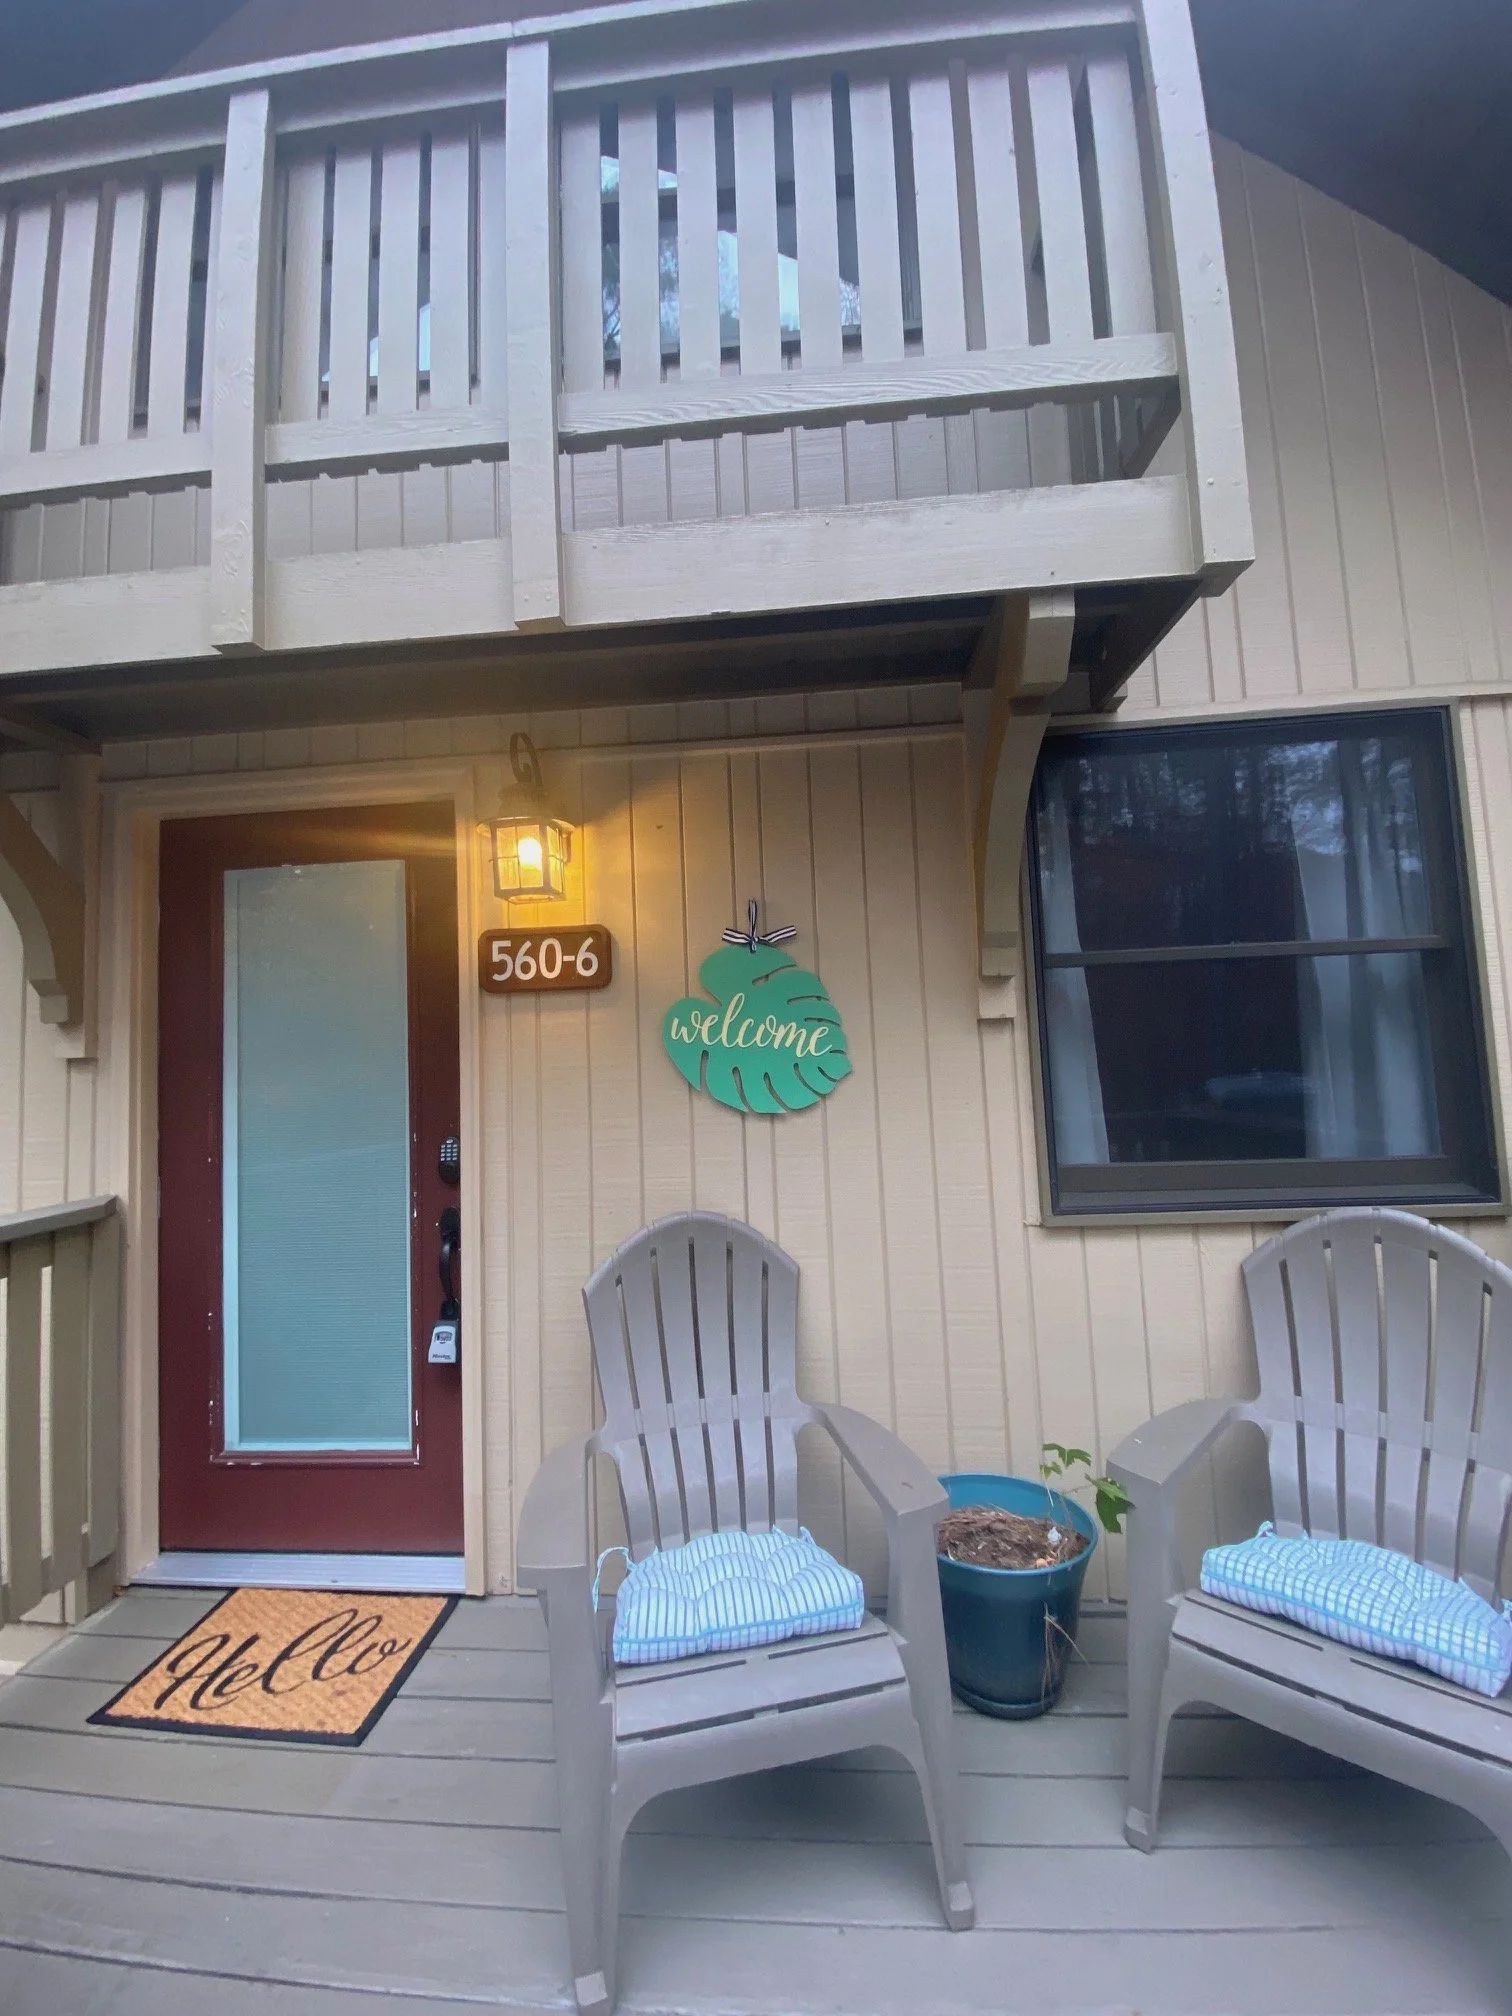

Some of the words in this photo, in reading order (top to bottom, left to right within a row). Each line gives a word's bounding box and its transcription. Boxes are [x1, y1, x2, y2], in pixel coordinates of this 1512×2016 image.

[491, 937, 599, 982] 560-6
[671, 993, 832, 1058] welcome
[154, 1608, 412, 1710] Hello
